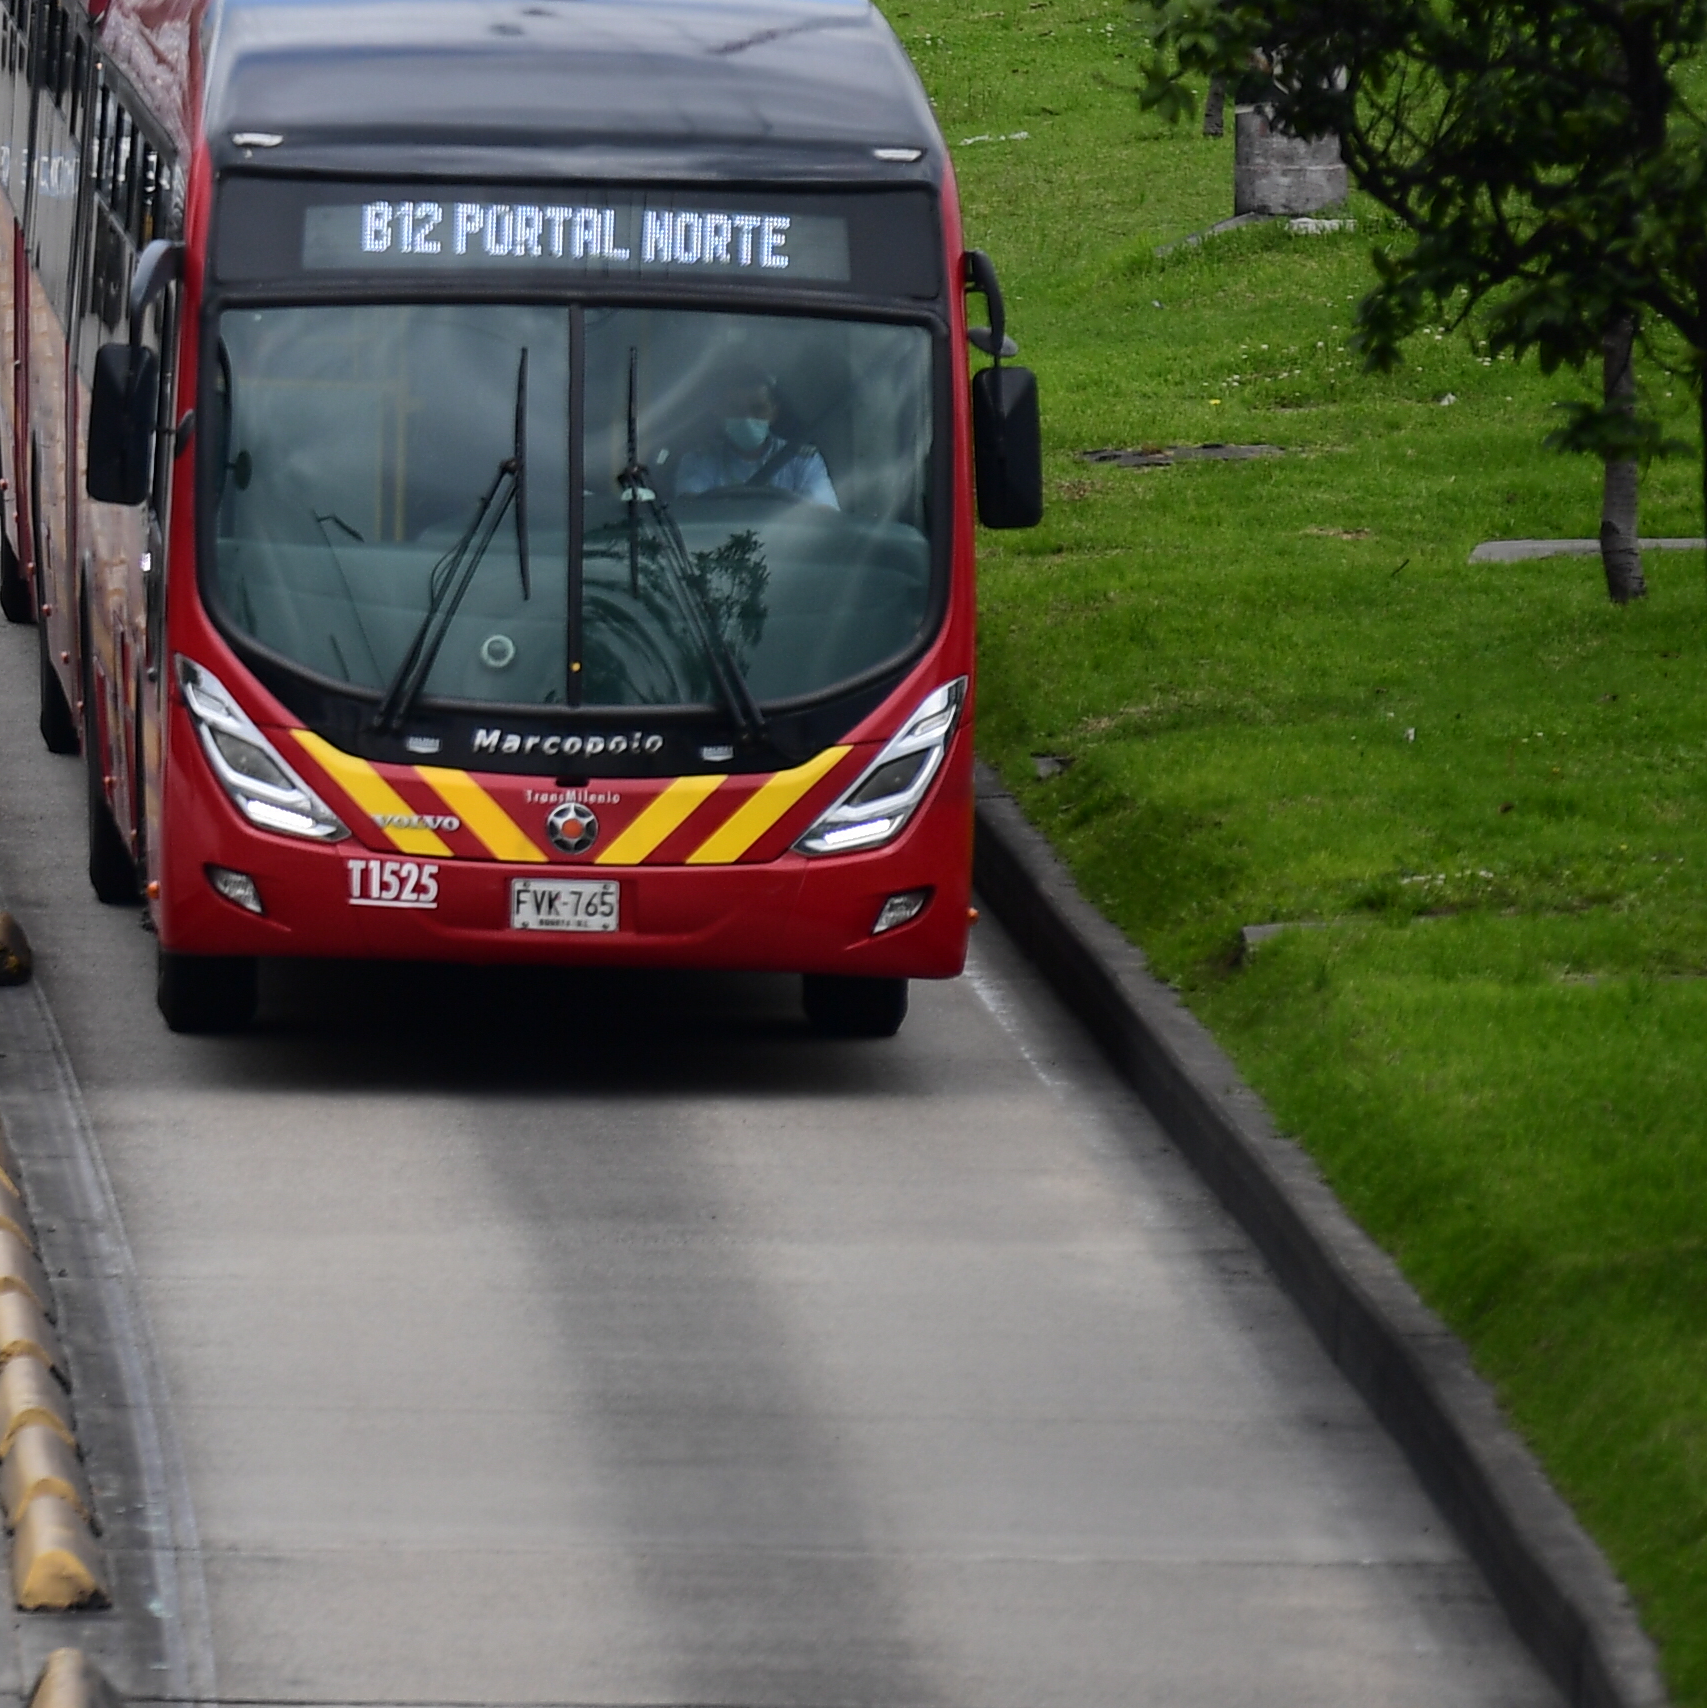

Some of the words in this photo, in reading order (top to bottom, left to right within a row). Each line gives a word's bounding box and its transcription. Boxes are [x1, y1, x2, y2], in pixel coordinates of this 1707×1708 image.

[361, 200, 443, 254] B12
[453, 202, 631, 262] PORTAL
[641, 209, 792, 269] NORTE
[473, 729, 665, 756] Marcopolo
[526, 789, 621, 805] TransMilenio
[374, 814, 461, 832] VOLVO
[347, 859, 440, 903] T1525
[515, 889, 615, 917] FVK-765
